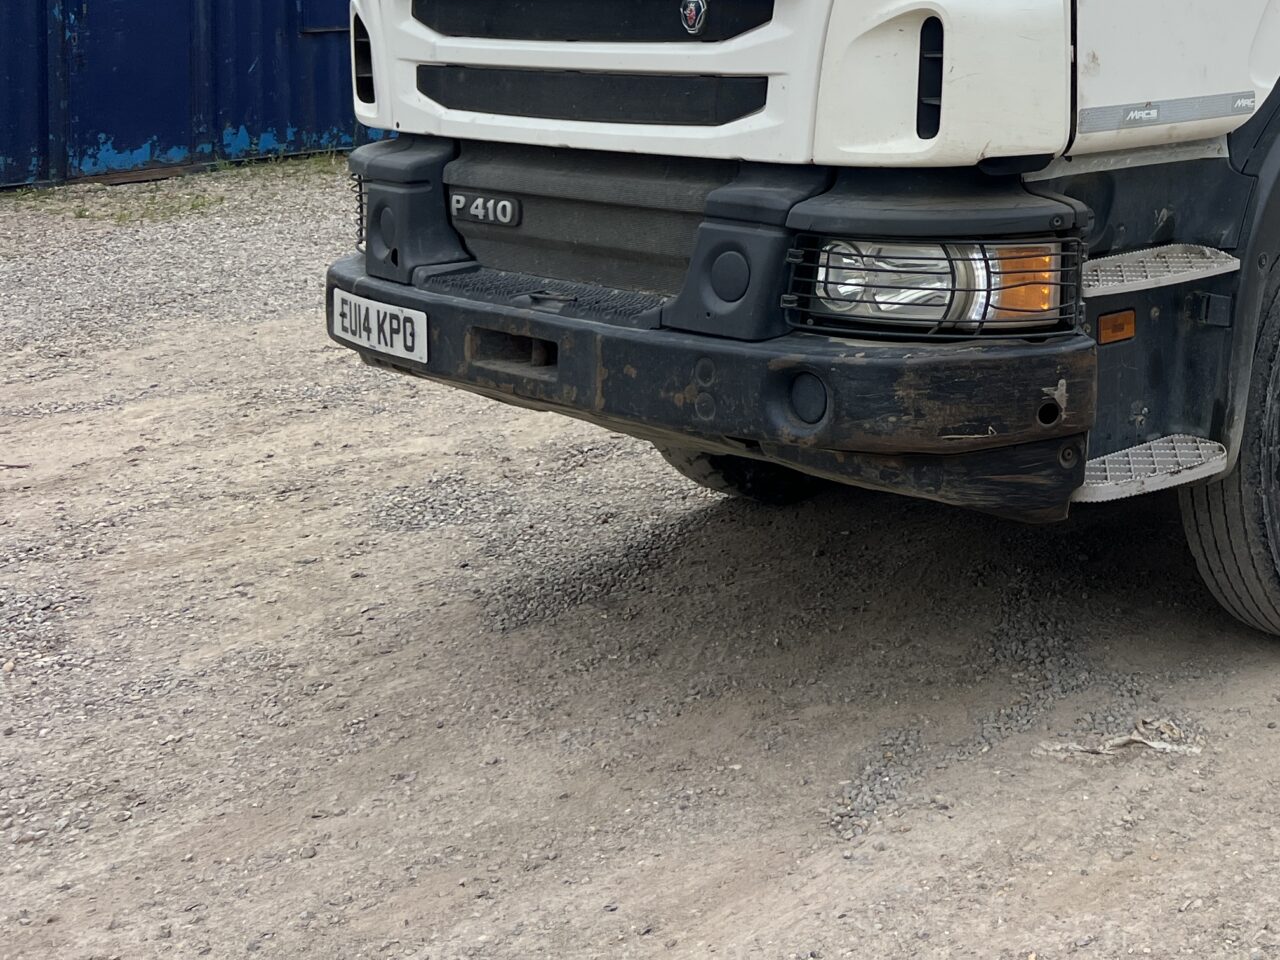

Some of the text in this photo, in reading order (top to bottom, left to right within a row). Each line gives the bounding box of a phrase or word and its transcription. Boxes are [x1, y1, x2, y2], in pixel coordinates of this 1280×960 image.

[451, 194, 513, 224] P 410
[339, 297, 415, 353] EU14 KPO
